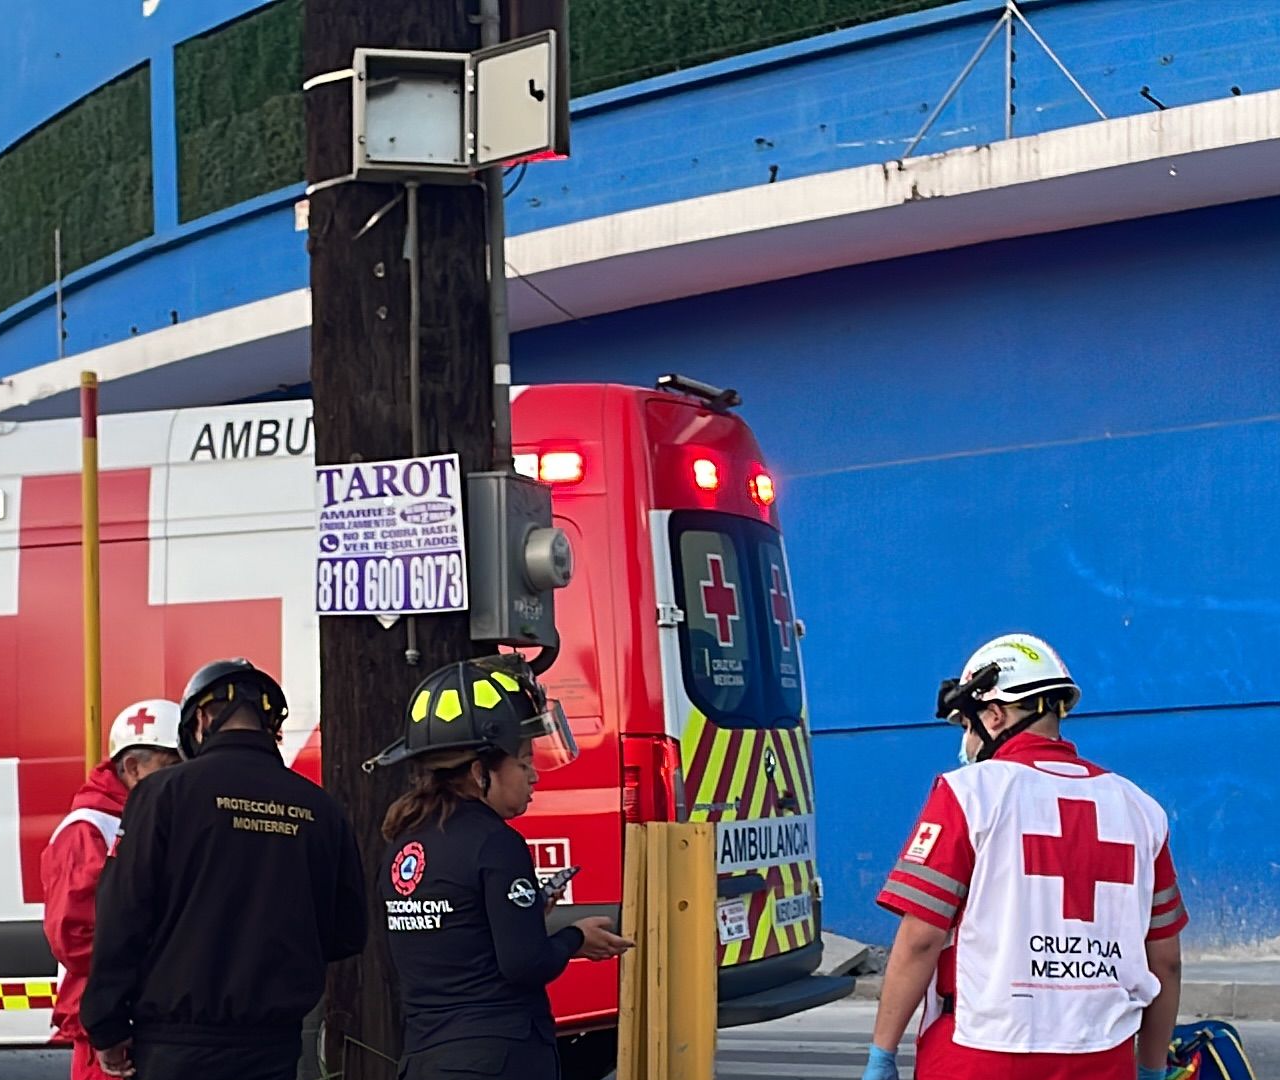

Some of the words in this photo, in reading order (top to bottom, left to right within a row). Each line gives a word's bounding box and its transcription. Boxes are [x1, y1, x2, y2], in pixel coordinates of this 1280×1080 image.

[190, 417, 311, 461] AMBU
[316, 458, 456, 508] TAROT
[321, 507, 396, 520] AMARRES
[343, 531, 359, 540] NO
[363, 530, 376, 540] SE
[381, 528, 418, 539] COBRA
[422, 525, 457, 536] HASTA
[344, 542, 369, 551] VER
[374, 535, 458, 550] RESULTADOS
[318, 559, 359, 611] 818
[365, 558, 405, 610] 600
[410, 554, 463, 609] 6073
[216, 796, 285, 817] PROTECCIÓN
[287, 806, 315, 821] CIVIL
[233, 816, 299, 836] MONTERREY
[720, 822, 810, 865] AMBULANCIA
[385, 897, 422, 913] TECCIÓN
[423, 900, 454, 913] CIVIL
[388, 914, 442, 930] ONTERREY
[1030, 935, 1082, 953] CRUZ
